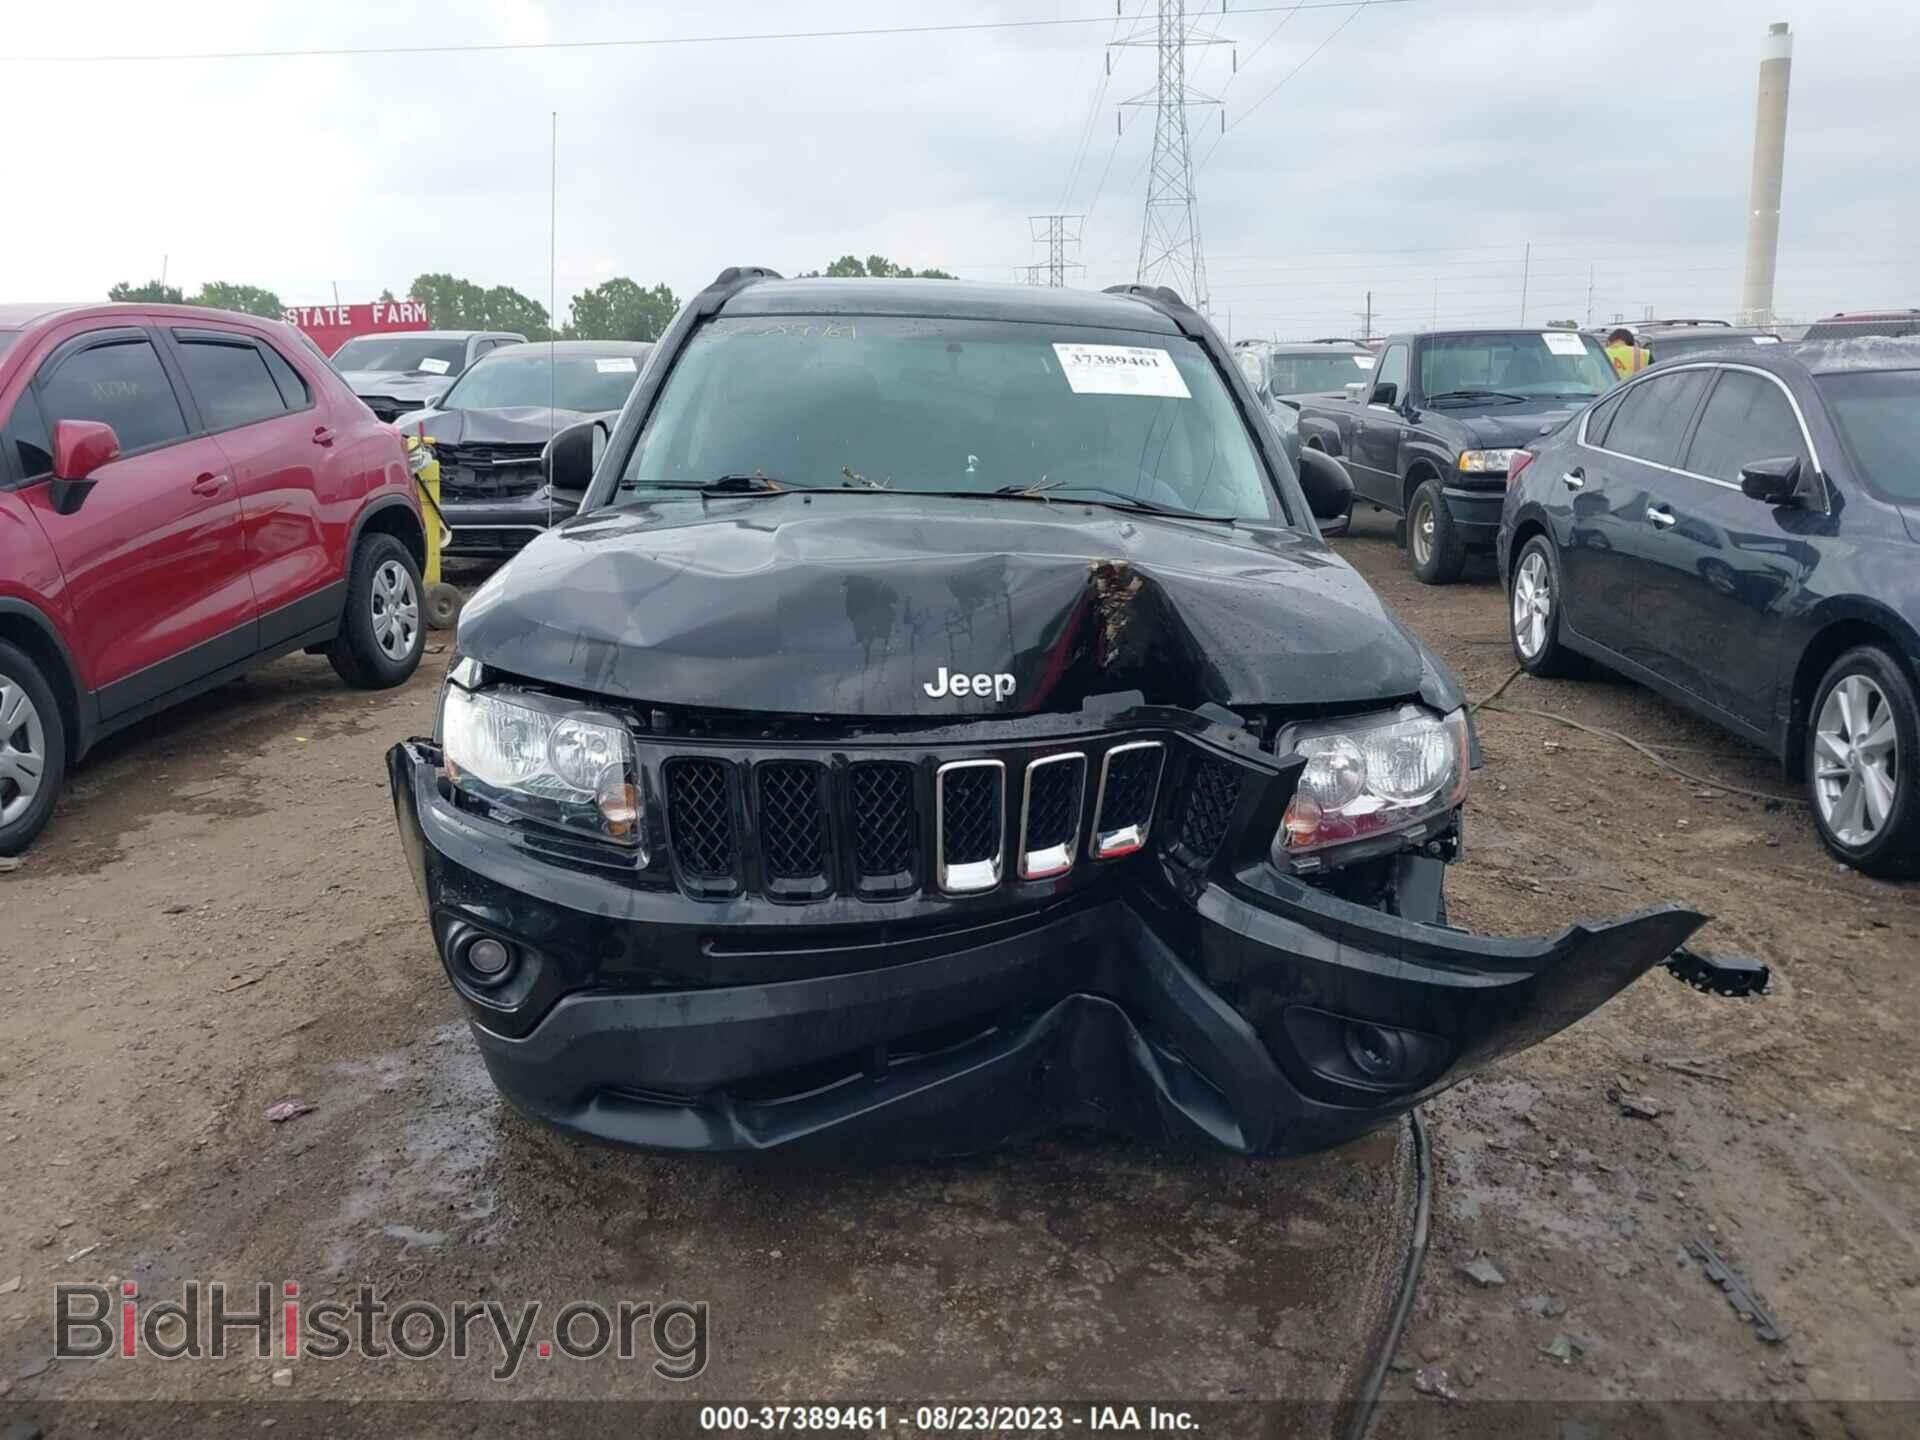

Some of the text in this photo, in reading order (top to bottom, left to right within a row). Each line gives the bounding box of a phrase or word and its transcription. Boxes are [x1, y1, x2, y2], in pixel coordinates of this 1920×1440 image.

[286, 303, 428, 327] STATE FARM
[1070, 353, 1161, 368] 37389461
[923, 666, 1017, 702] Jeep
